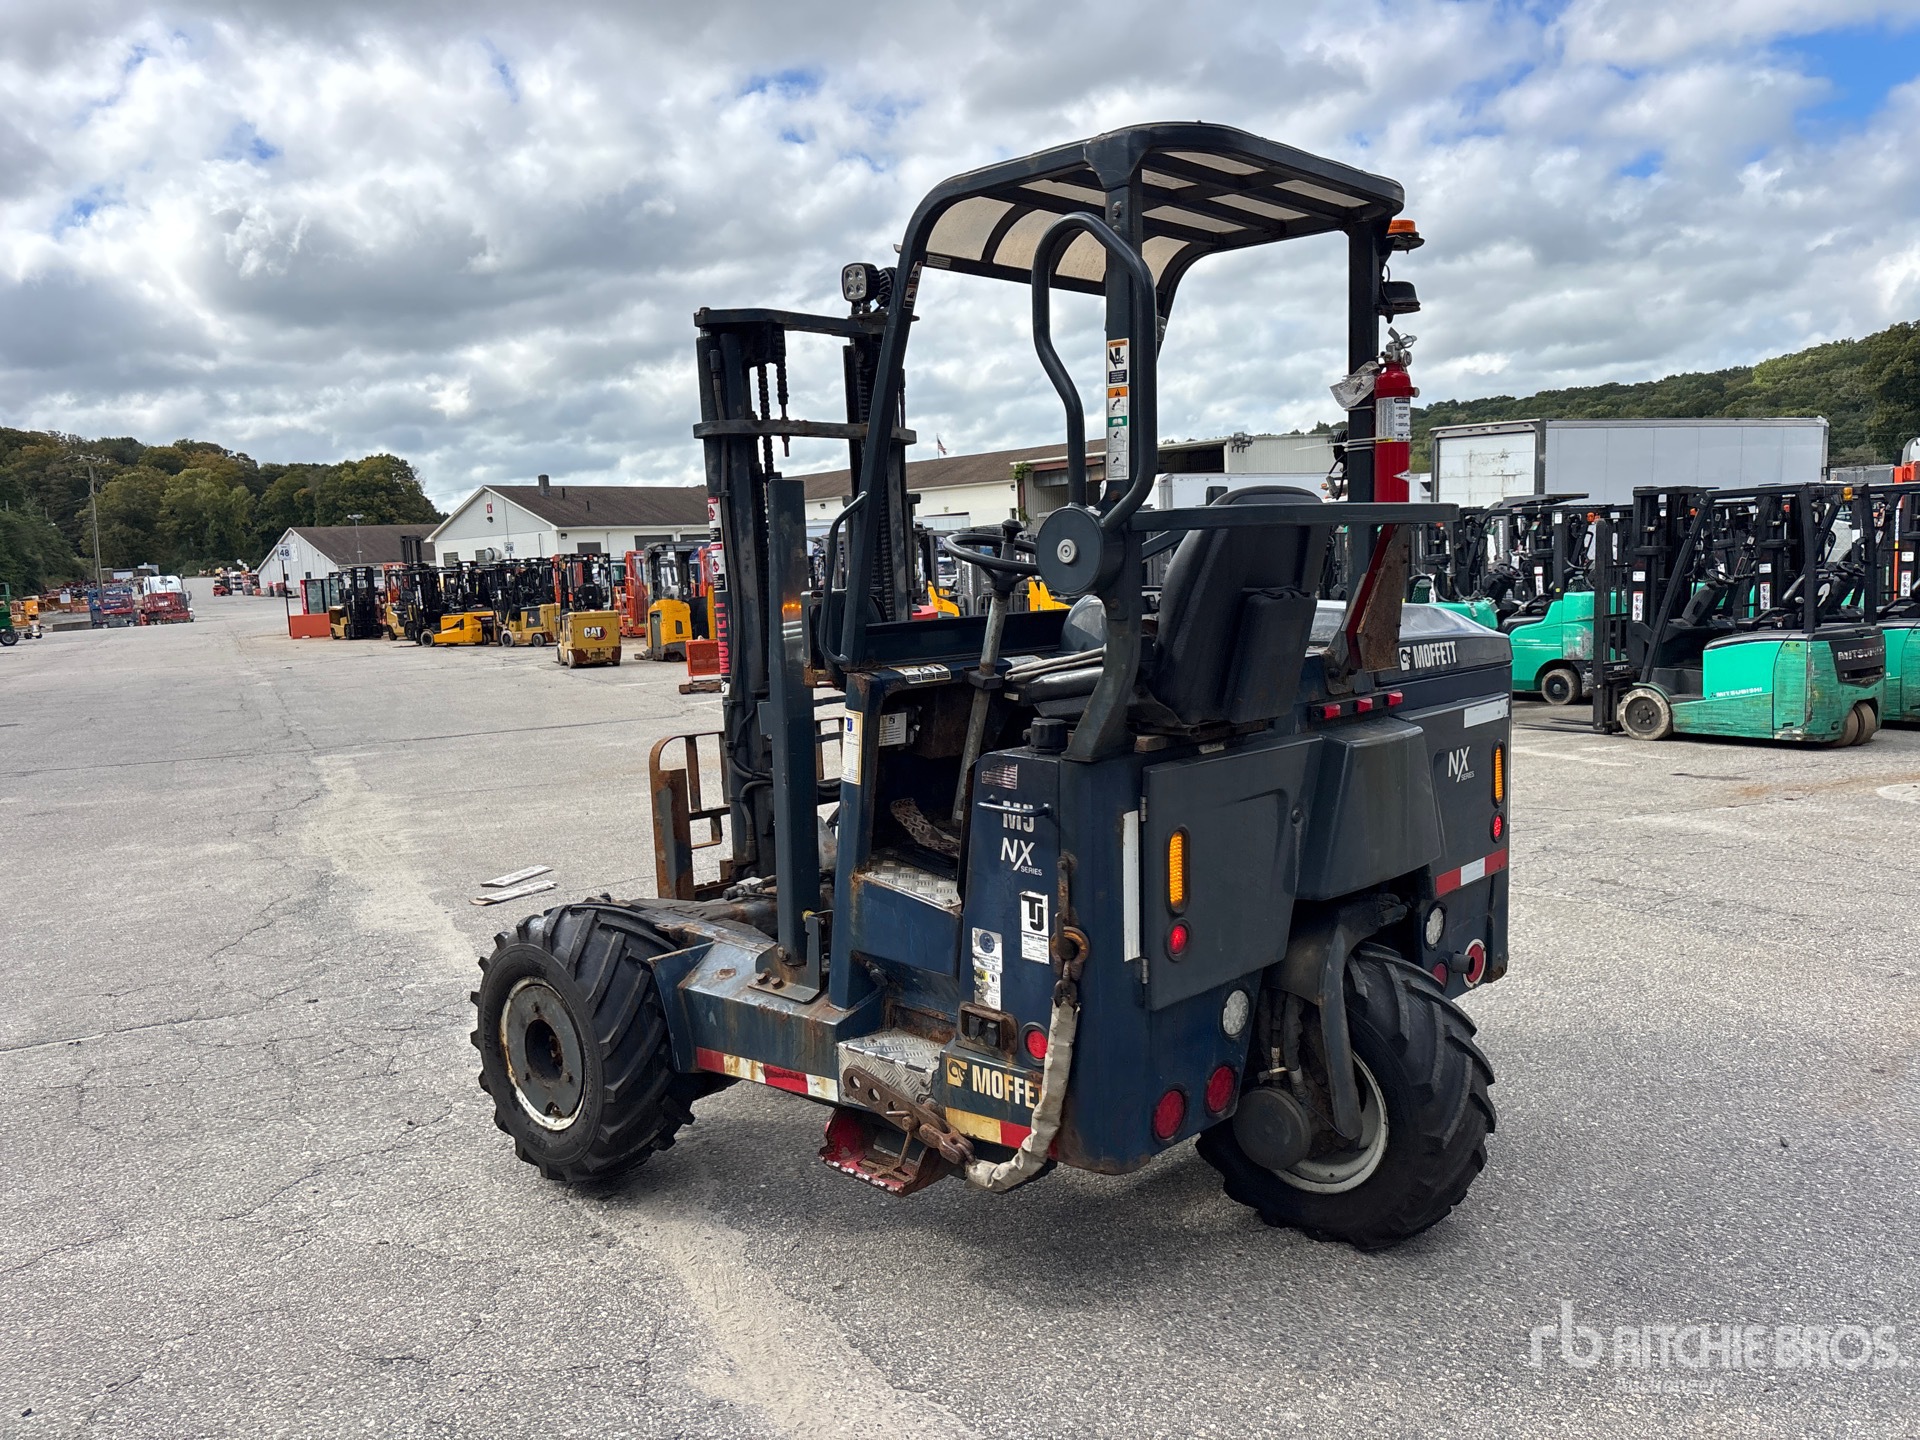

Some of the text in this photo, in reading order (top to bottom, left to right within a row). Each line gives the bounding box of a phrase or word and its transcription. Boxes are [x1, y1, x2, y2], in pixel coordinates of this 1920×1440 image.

[280, 549, 289, 557] 48
[584, 626, 602, 638] CAT
[1412, 640, 1457, 669] MOFFETT
[1716, 686, 1763, 698] MITSUBISHI
[1448, 745, 1470, 783] NX
[1460, 770, 1475, 781] SERIES
[1000, 837, 1035, 871] NX
[1020, 865, 1043, 876] SERIES
[971, 1064, 1043, 1110] MOFFE
